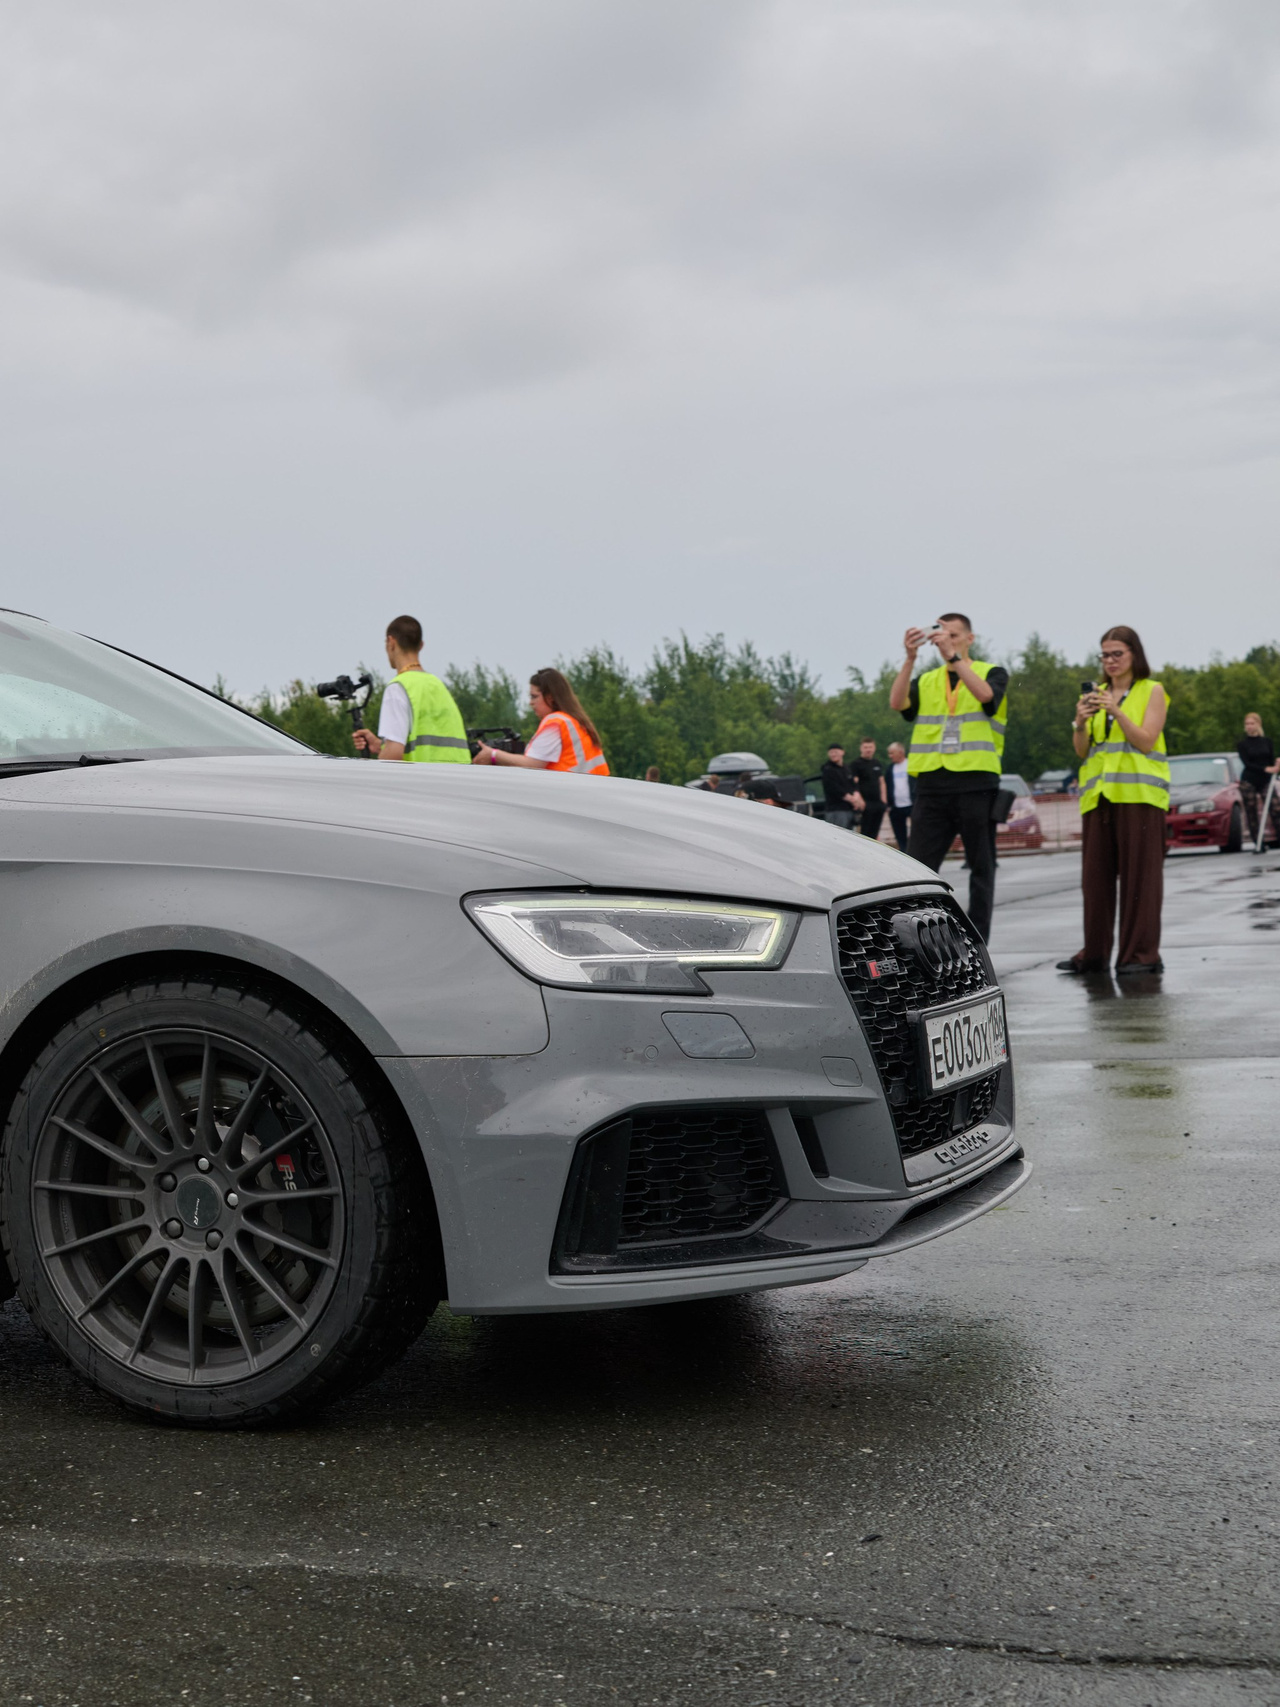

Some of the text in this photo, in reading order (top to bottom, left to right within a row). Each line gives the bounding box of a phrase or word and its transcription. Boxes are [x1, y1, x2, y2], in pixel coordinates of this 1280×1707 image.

[873, 960, 899, 976] RS3
[934, 1130, 992, 1166] quattro
[279, 1164, 298, 1191] RS
